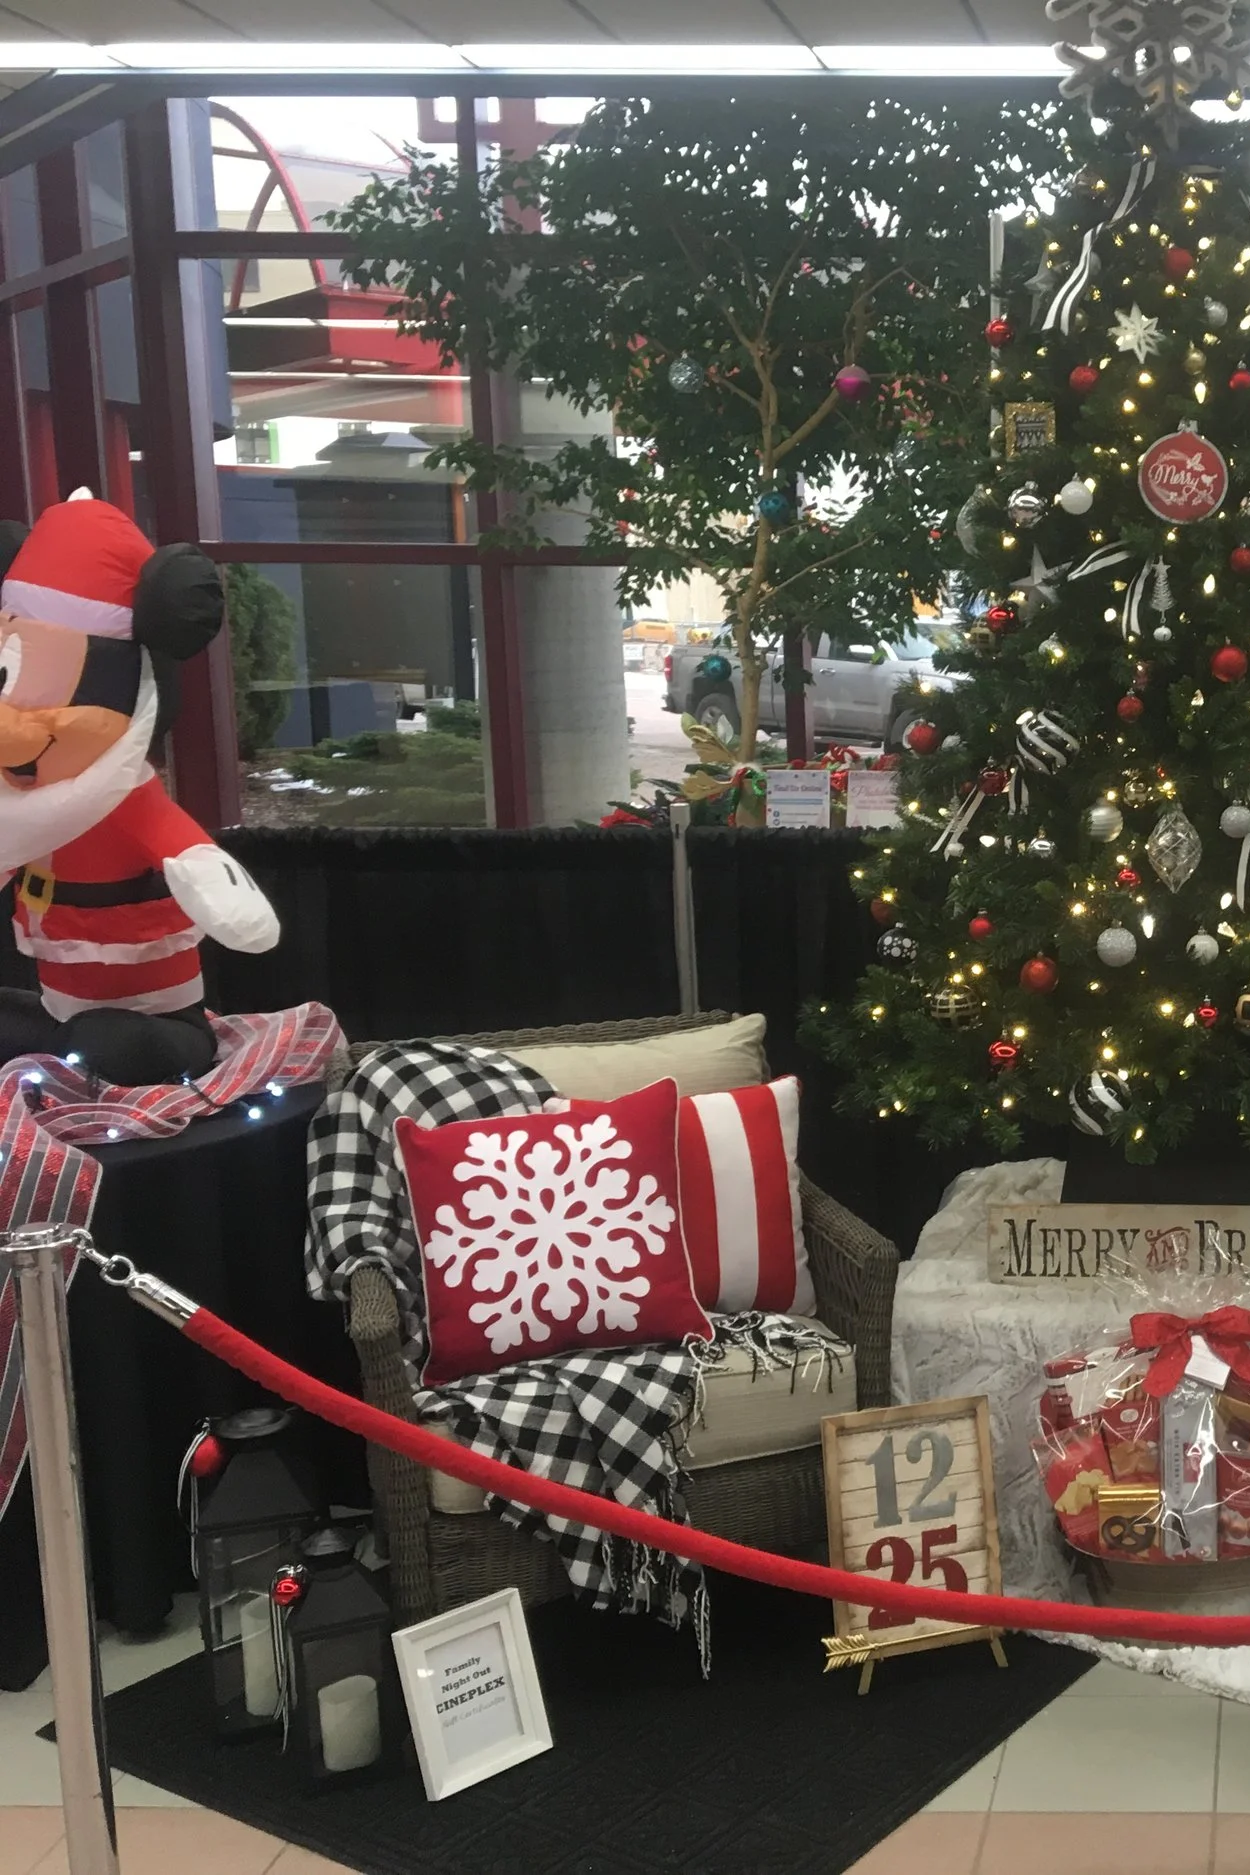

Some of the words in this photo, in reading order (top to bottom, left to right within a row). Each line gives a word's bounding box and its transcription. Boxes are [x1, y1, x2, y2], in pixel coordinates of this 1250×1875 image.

[1148, 463, 1201, 495] Merry
[1003, 1218, 1140, 1278] MERRY
[865, 1430, 957, 1528] 12
[865, 1524, 968, 1630] 25
[441, 1676, 471, 1694] Night
[472, 1667, 491, 1679] Out
[444, 1656, 481, 1677] Family
[436, 1676, 505, 1714] CINEPLEX
